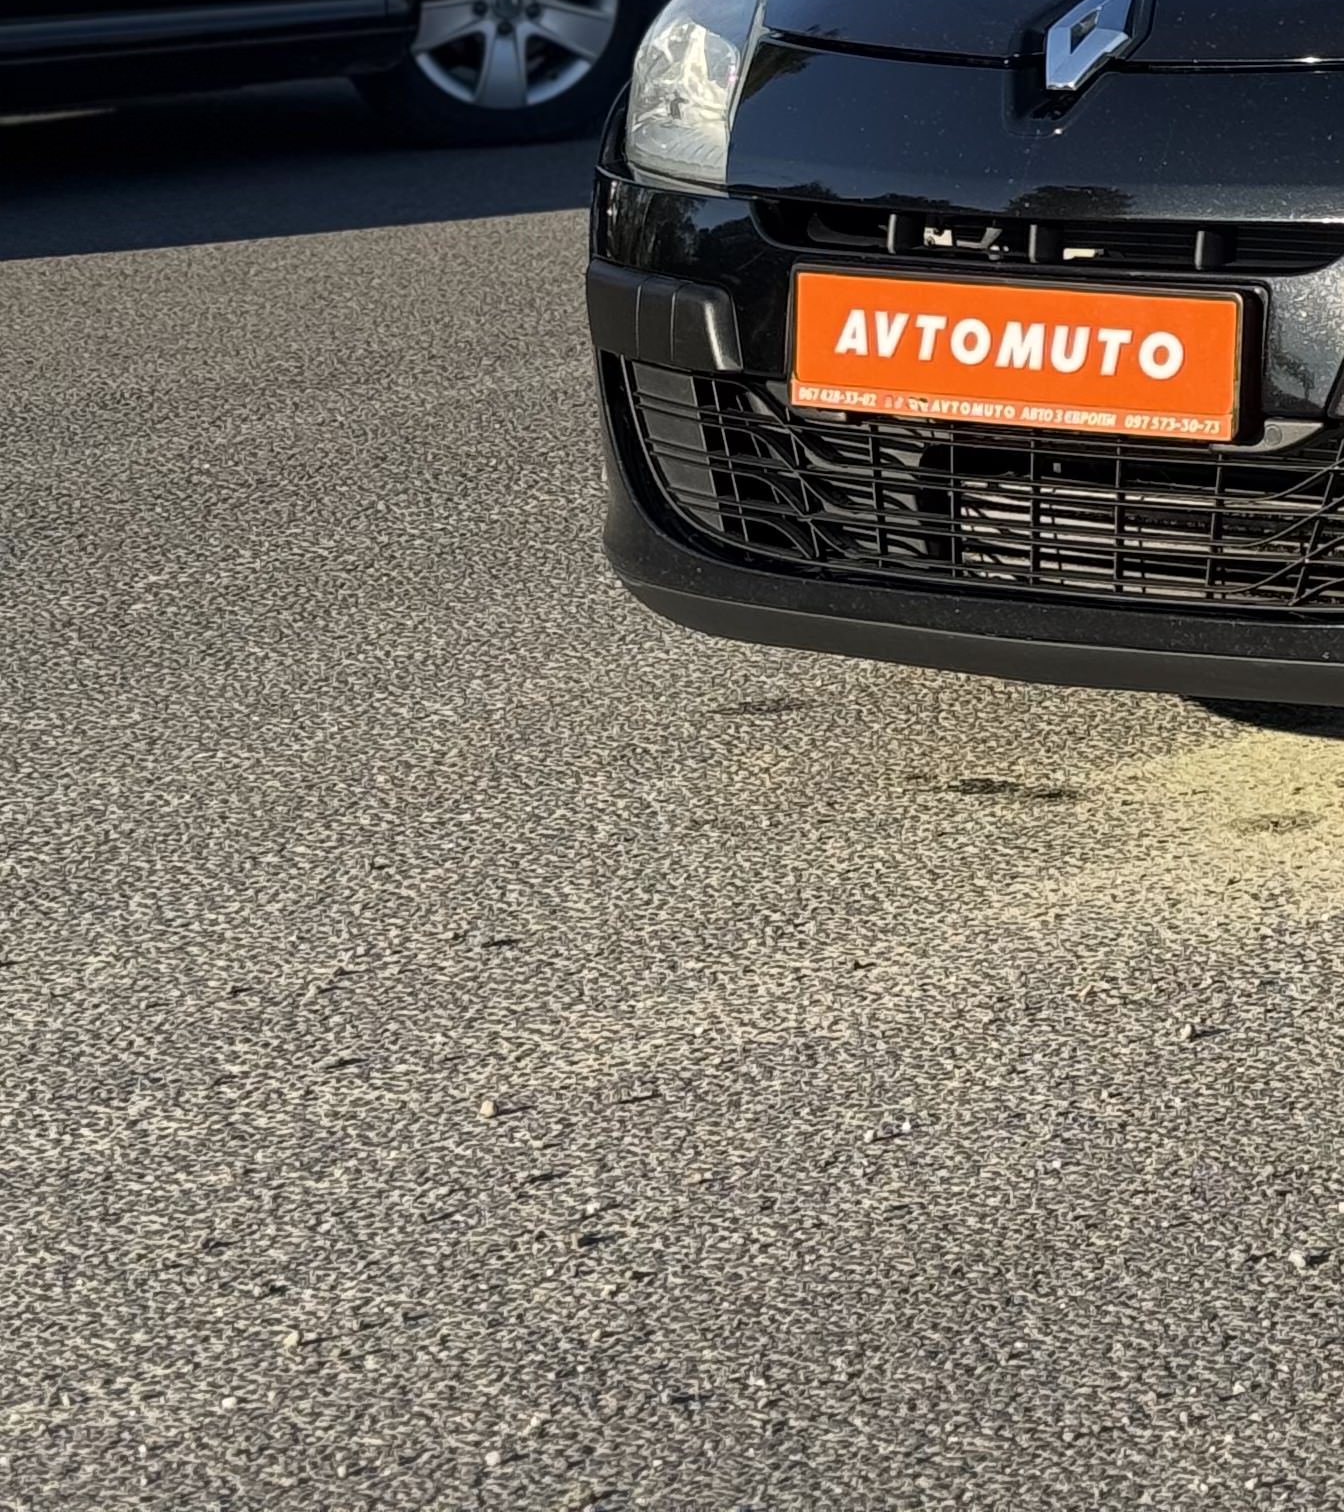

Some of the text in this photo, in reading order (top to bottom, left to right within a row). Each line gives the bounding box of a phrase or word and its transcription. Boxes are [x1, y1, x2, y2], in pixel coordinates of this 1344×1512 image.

[834, 309, 1184, 380] AVTOMUTO
[930, 397, 1016, 419] AVTOMUTO
[1125, 414, 1151, 430] 097
[1151, 416, 1221, 434] 573-30-73
